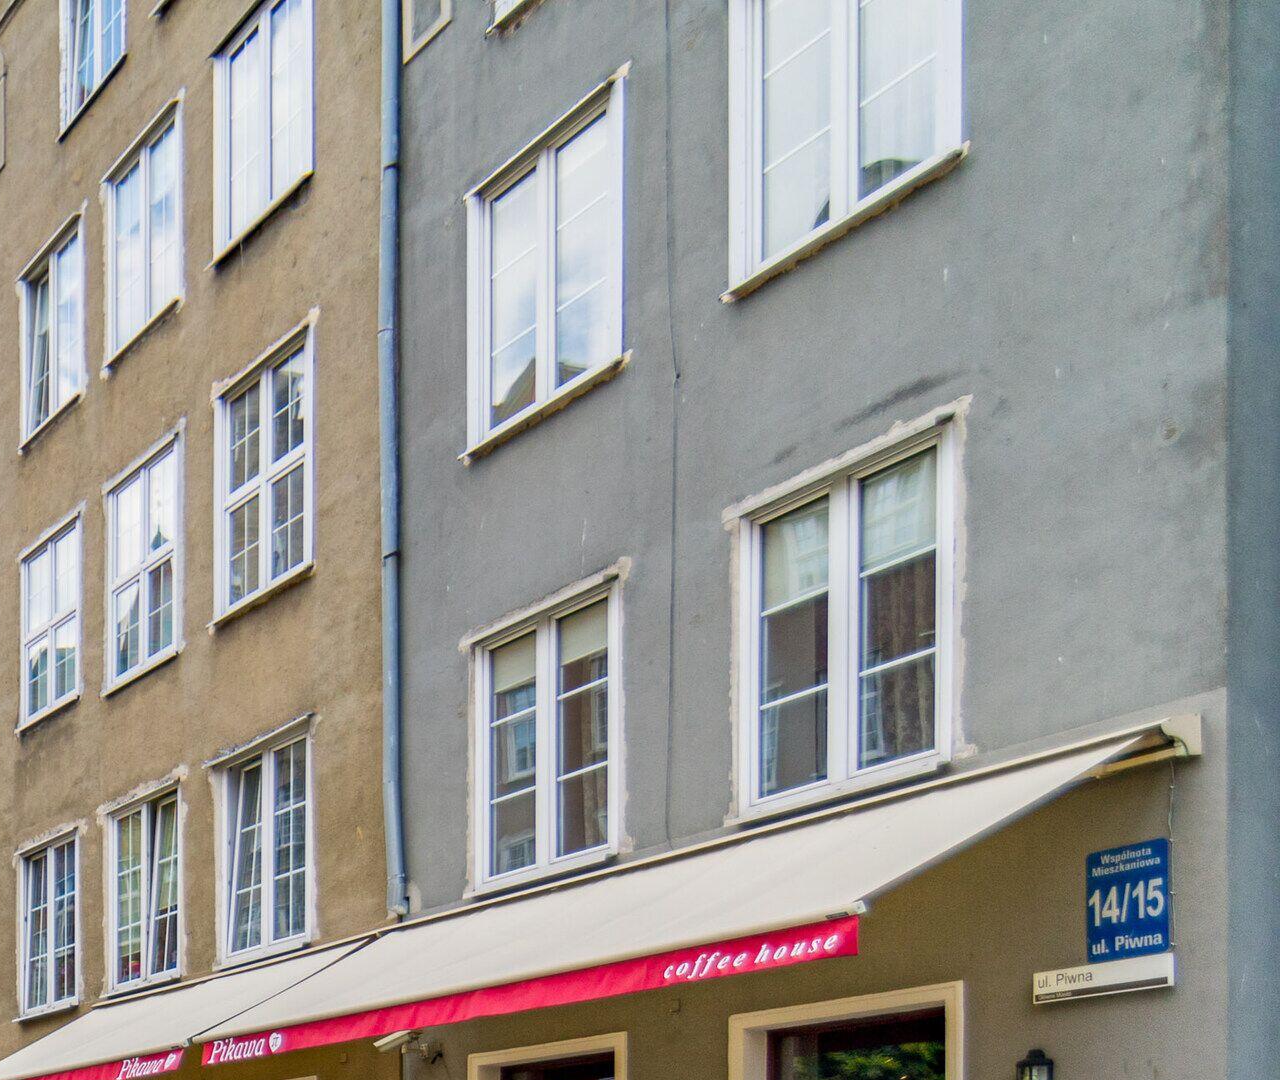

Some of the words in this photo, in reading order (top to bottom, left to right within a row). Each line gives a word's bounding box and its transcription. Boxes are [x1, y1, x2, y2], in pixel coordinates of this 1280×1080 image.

[1092, 856, 1161, 877] Mieszkaniowa
[1101, 847, 1152, 865] Wspólnota
[1089, 877, 1165, 927] 14/15
[1092, 938, 1110, 955] ul.
[1115, 932, 1162, 951] Piwna
[663, 951, 749, 980] coffee
[754, 933, 839, 964] house
[1038, 976, 1051, 988] ul.
[1056, 971, 1093, 986] Piwna
[208, 1037, 265, 1065] Pikawa
[116, 1057, 164, 1080] Pikawa
